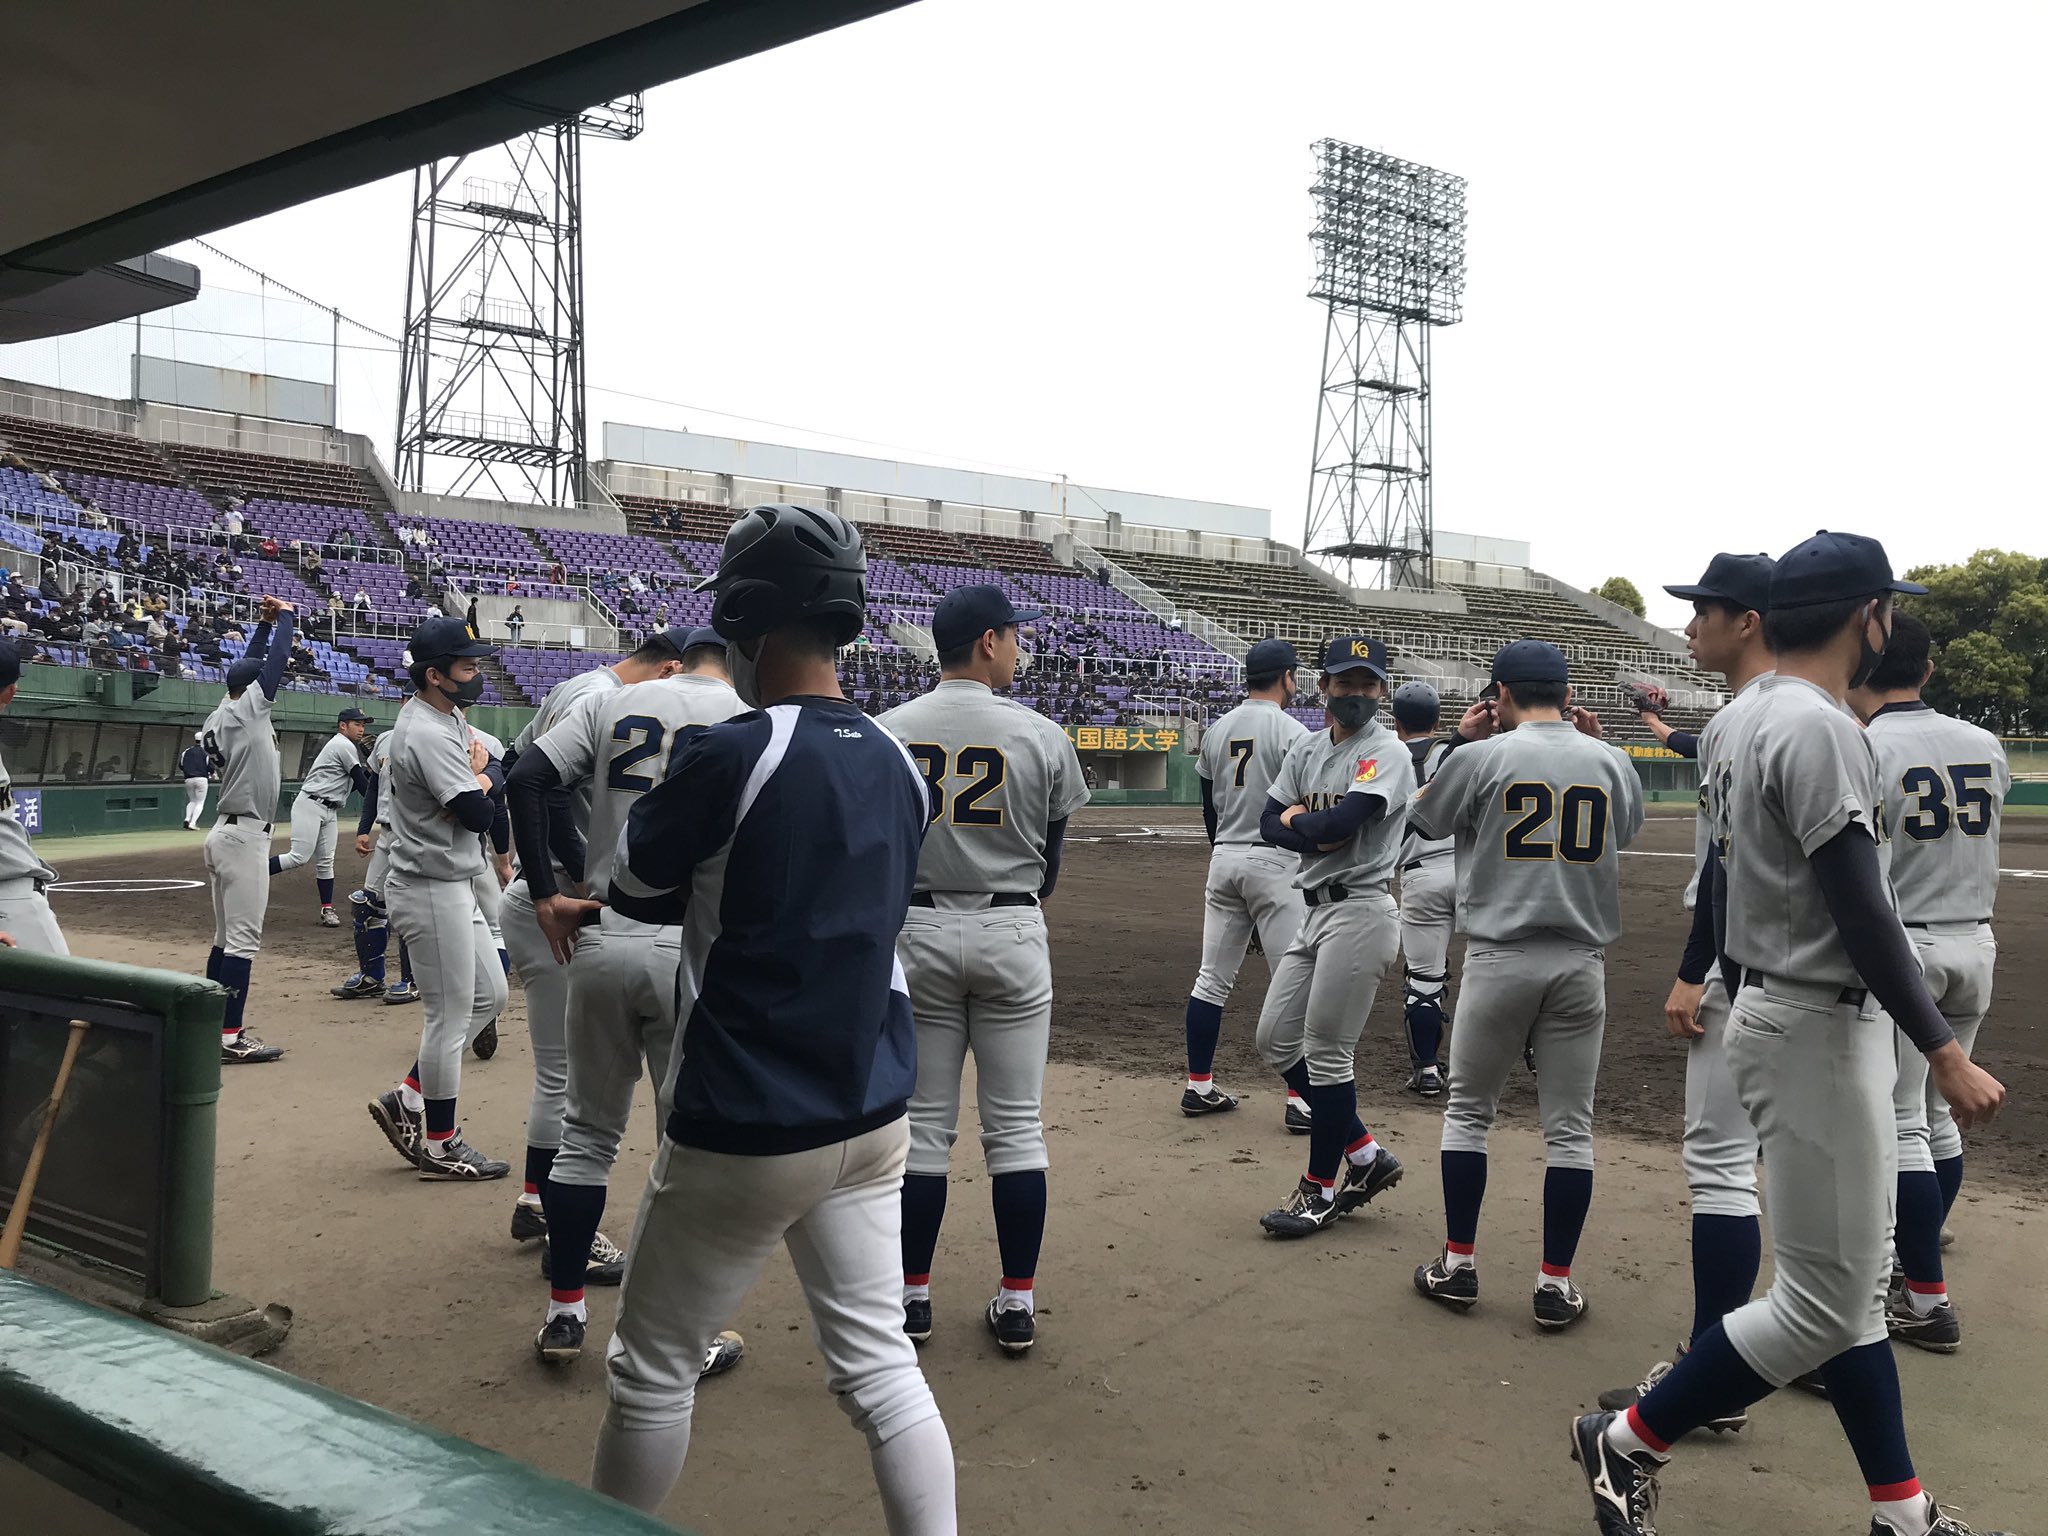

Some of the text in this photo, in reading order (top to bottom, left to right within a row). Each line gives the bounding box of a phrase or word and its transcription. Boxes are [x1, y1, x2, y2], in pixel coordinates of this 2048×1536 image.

[1351, 640, 1370, 658] KG
[1228, 737, 1256, 788] 7
[1618, 745, 1684, 759] 不動産株式
[1503, 781, 1610, 865] 20
[1900, 762, 1993, 843] 35
